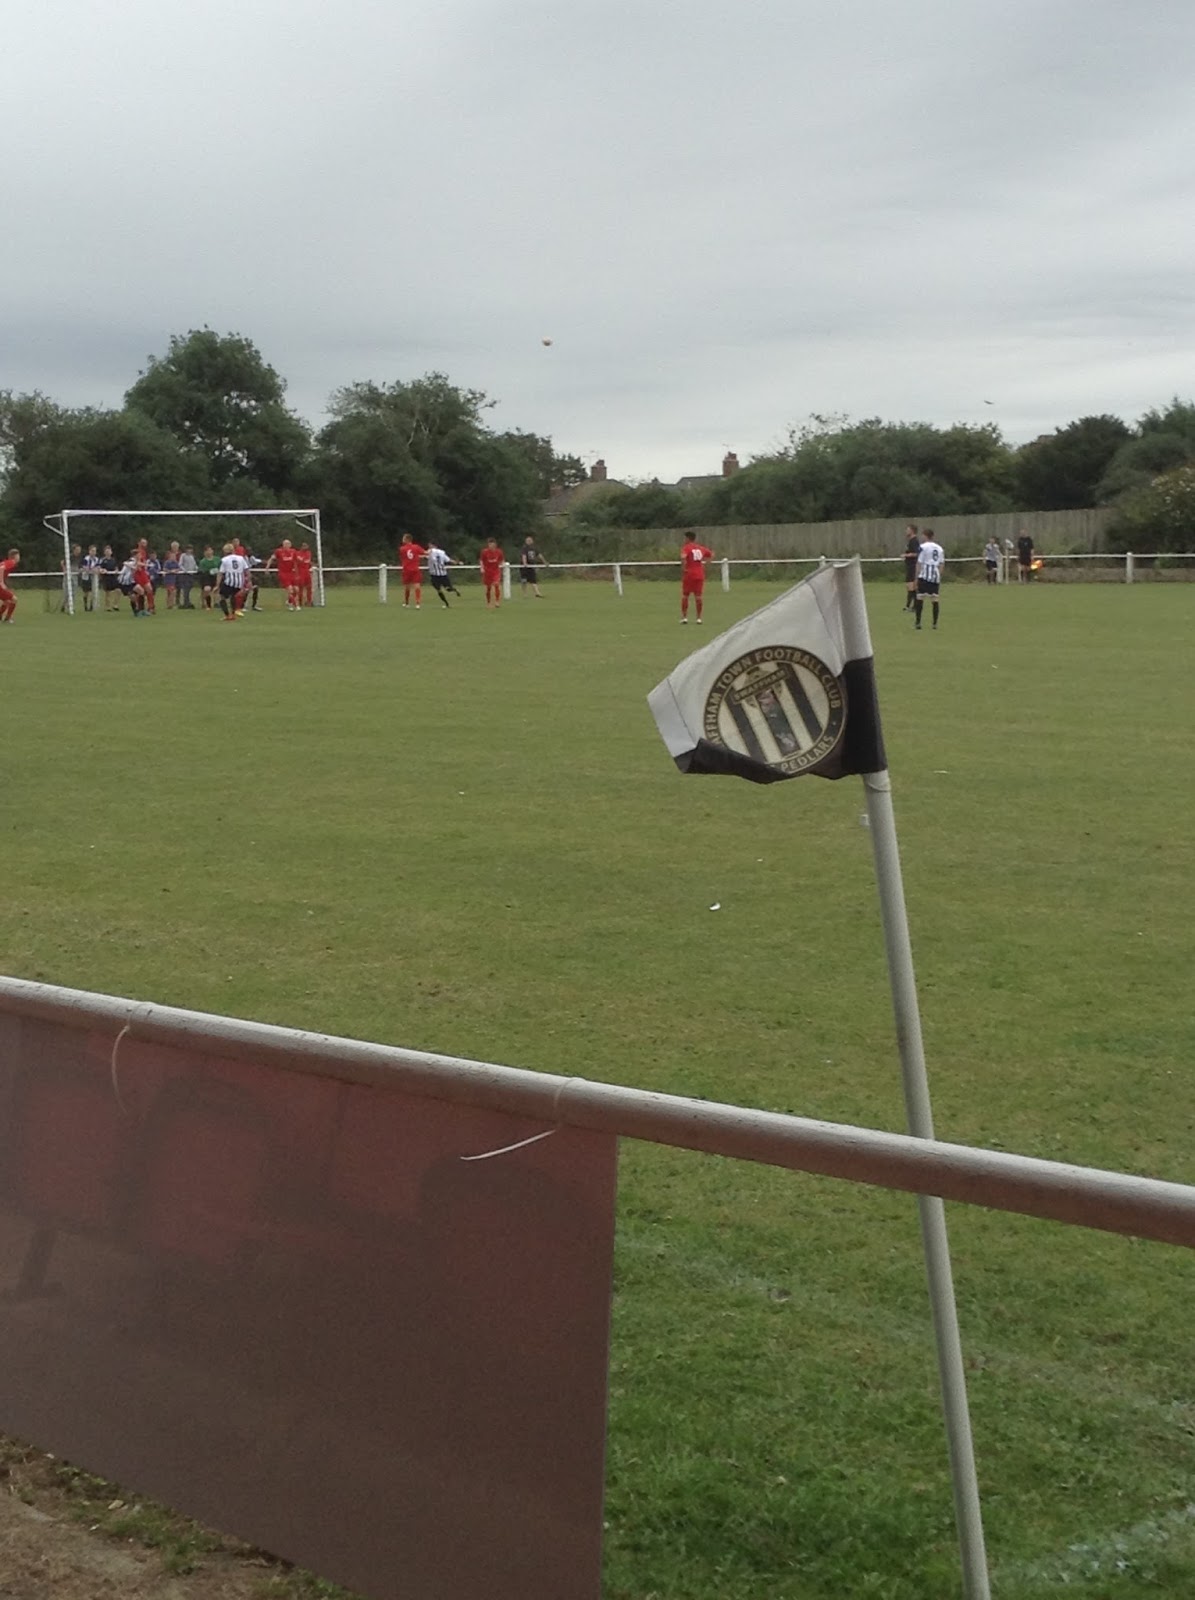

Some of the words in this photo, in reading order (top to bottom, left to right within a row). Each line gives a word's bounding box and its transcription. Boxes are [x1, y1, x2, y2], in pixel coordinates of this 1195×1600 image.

[406, 549, 414, 560] 6
[691, 549, 703, 561] 10
[932, 549, 940, 562] 8
[704, 691, 722, 745] AFFHAM
[717, 656, 753, 690] TOWN
[754, 648, 822, 674] FOOTBALL
[822, 674, 842, 709] CLUB
[780, 735, 835, 773] PEDLARS
